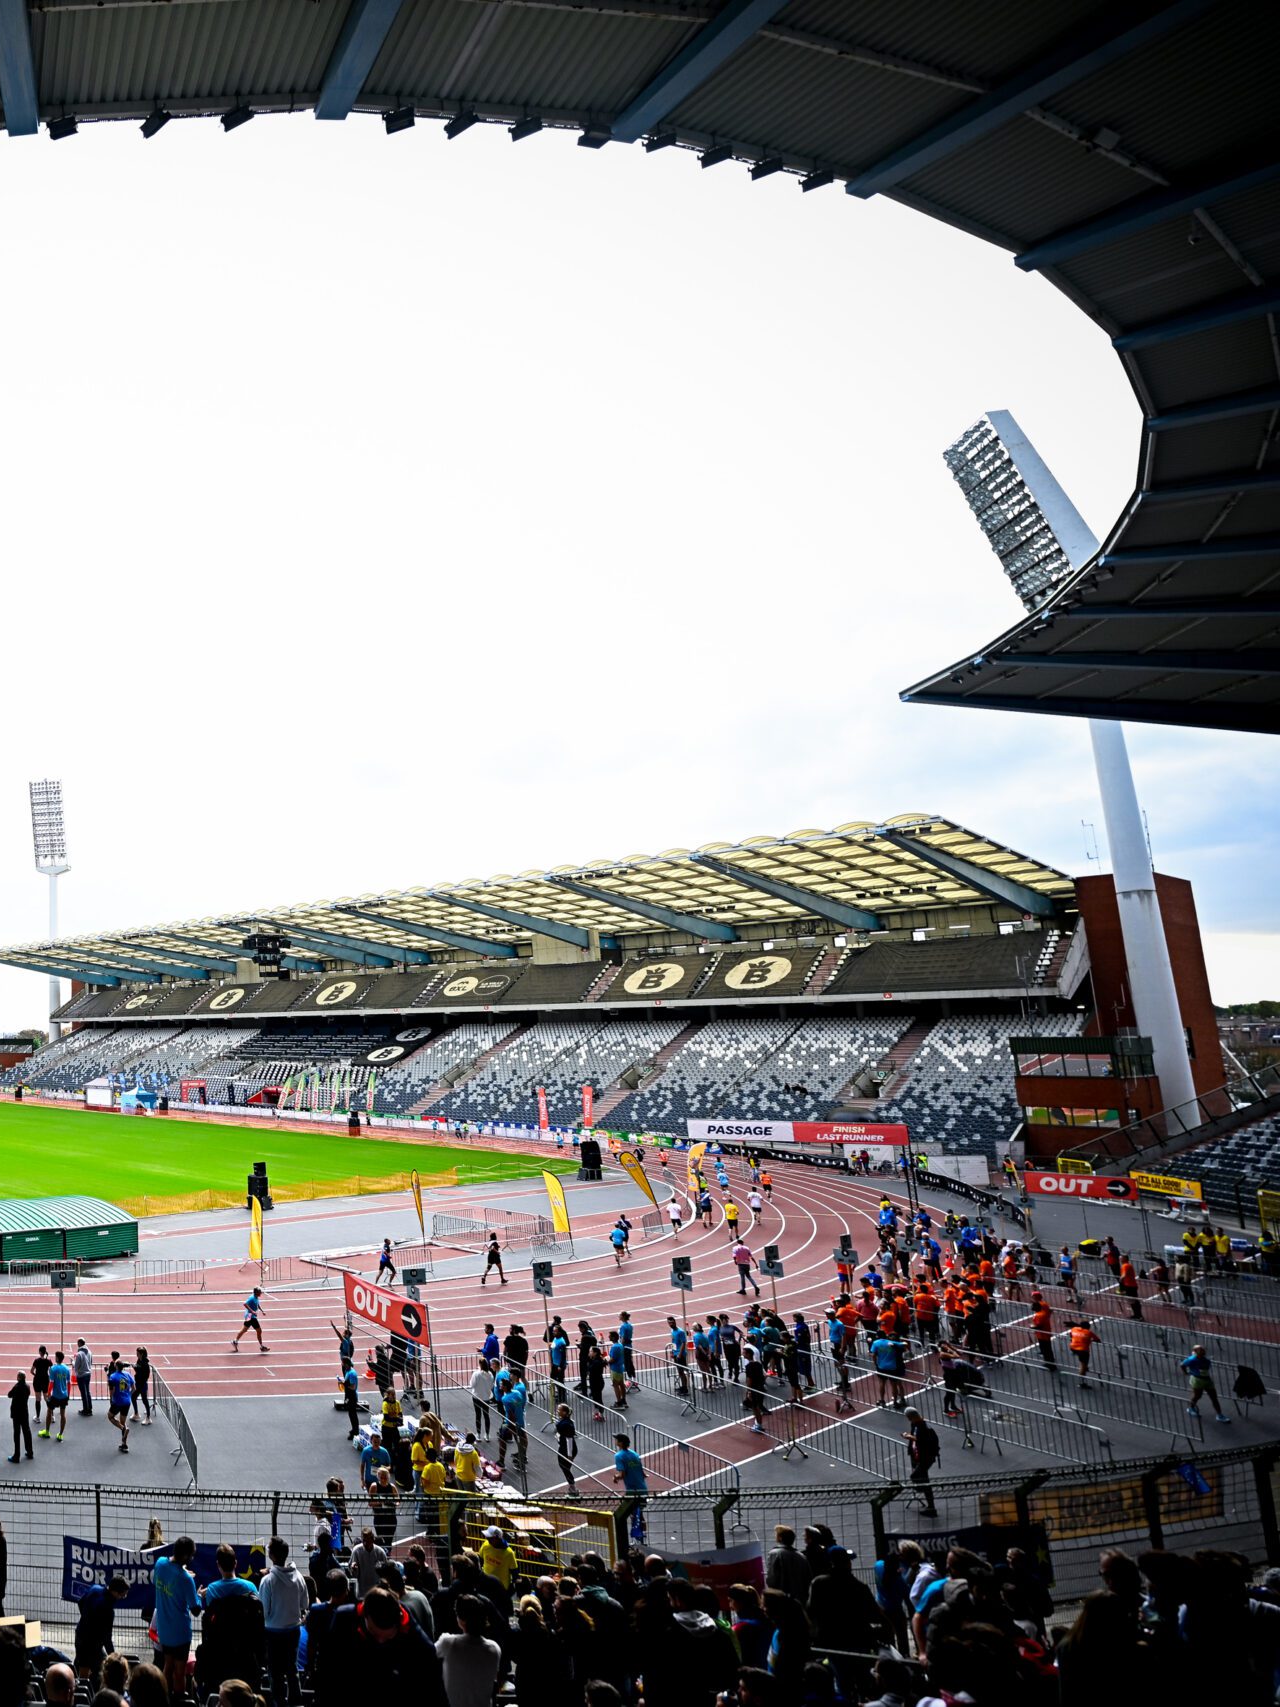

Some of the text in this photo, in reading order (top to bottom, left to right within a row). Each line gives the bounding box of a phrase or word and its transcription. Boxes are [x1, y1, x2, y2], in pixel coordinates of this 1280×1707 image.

[707, 1125, 773, 1136] PASSAGE
[816, 1133, 884, 1142] LAST RUNNER
[832, 1126, 866, 1134] FINISH
[1039, 1176, 1094, 1194] OUT
[353, 1284, 392, 1323] OUT
[71, 1544, 155, 1566] RUNNING
[71, 1562, 106, 1585] FOR
